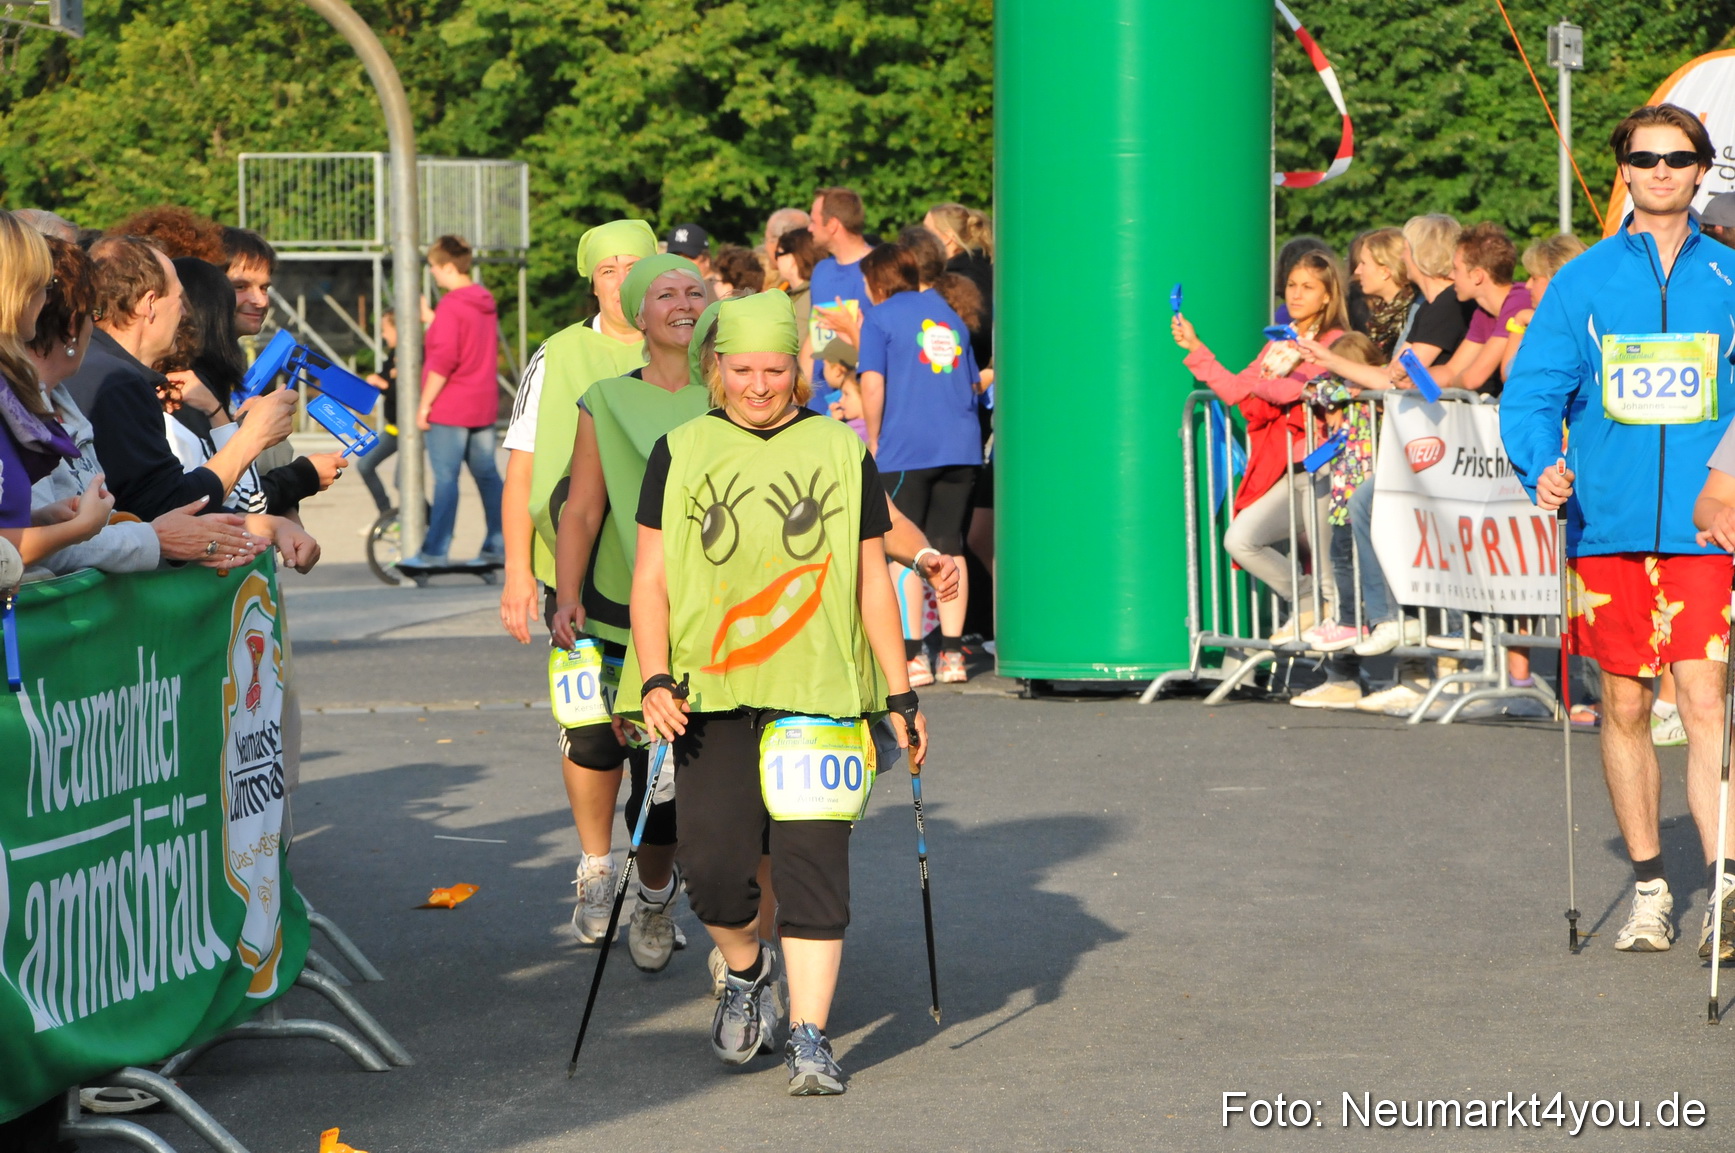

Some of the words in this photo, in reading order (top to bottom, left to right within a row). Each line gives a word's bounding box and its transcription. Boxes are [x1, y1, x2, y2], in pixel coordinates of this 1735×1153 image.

[1609, 366, 1701, 399] 1329
[1621, 401, 1666, 411] Johannes
[1407, 443, 1442, 465] NEU!
[556, 671, 602, 704] 10
[19, 645, 182, 818] Neumarkter
[767, 753, 863, 792] 1100
[231, 850, 254, 870] Das
